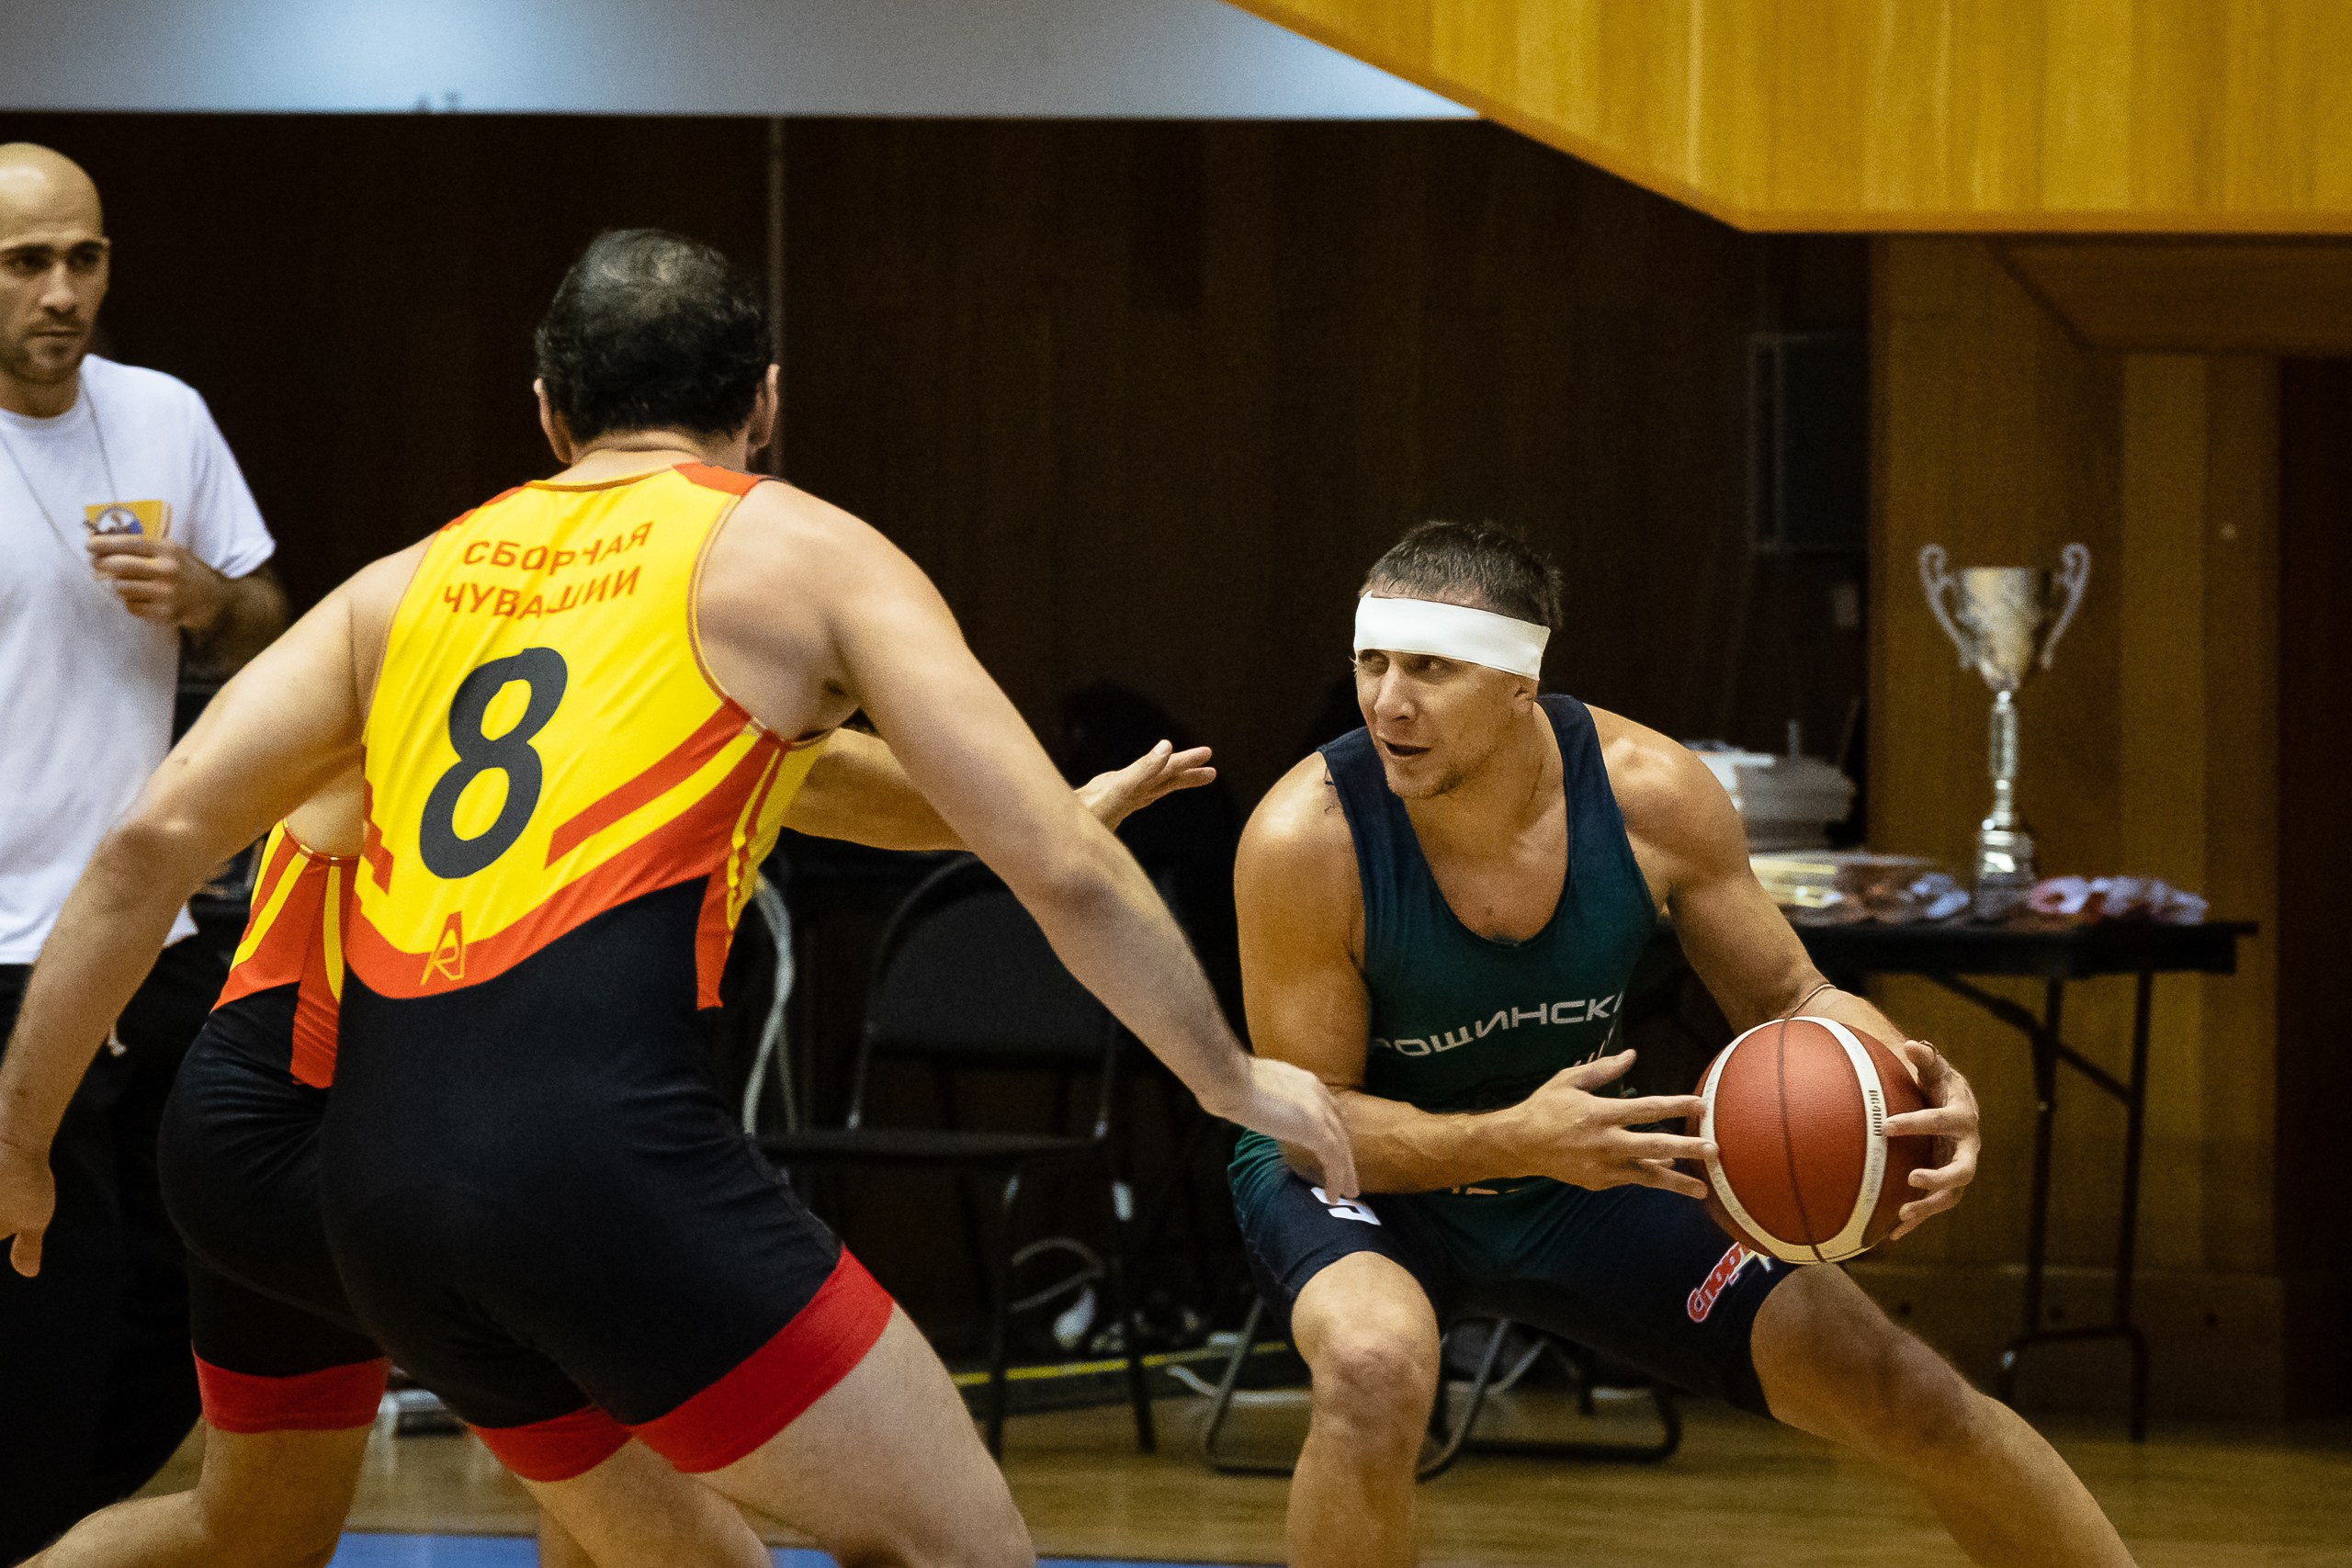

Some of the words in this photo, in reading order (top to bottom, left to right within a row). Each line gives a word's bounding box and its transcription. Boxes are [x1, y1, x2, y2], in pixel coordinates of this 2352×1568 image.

[444, 566, 641, 620] ЧУВАШИИ
[419, 646, 569, 880] 8
[1373, 992, 1623, 1056] ОЩИНСК
